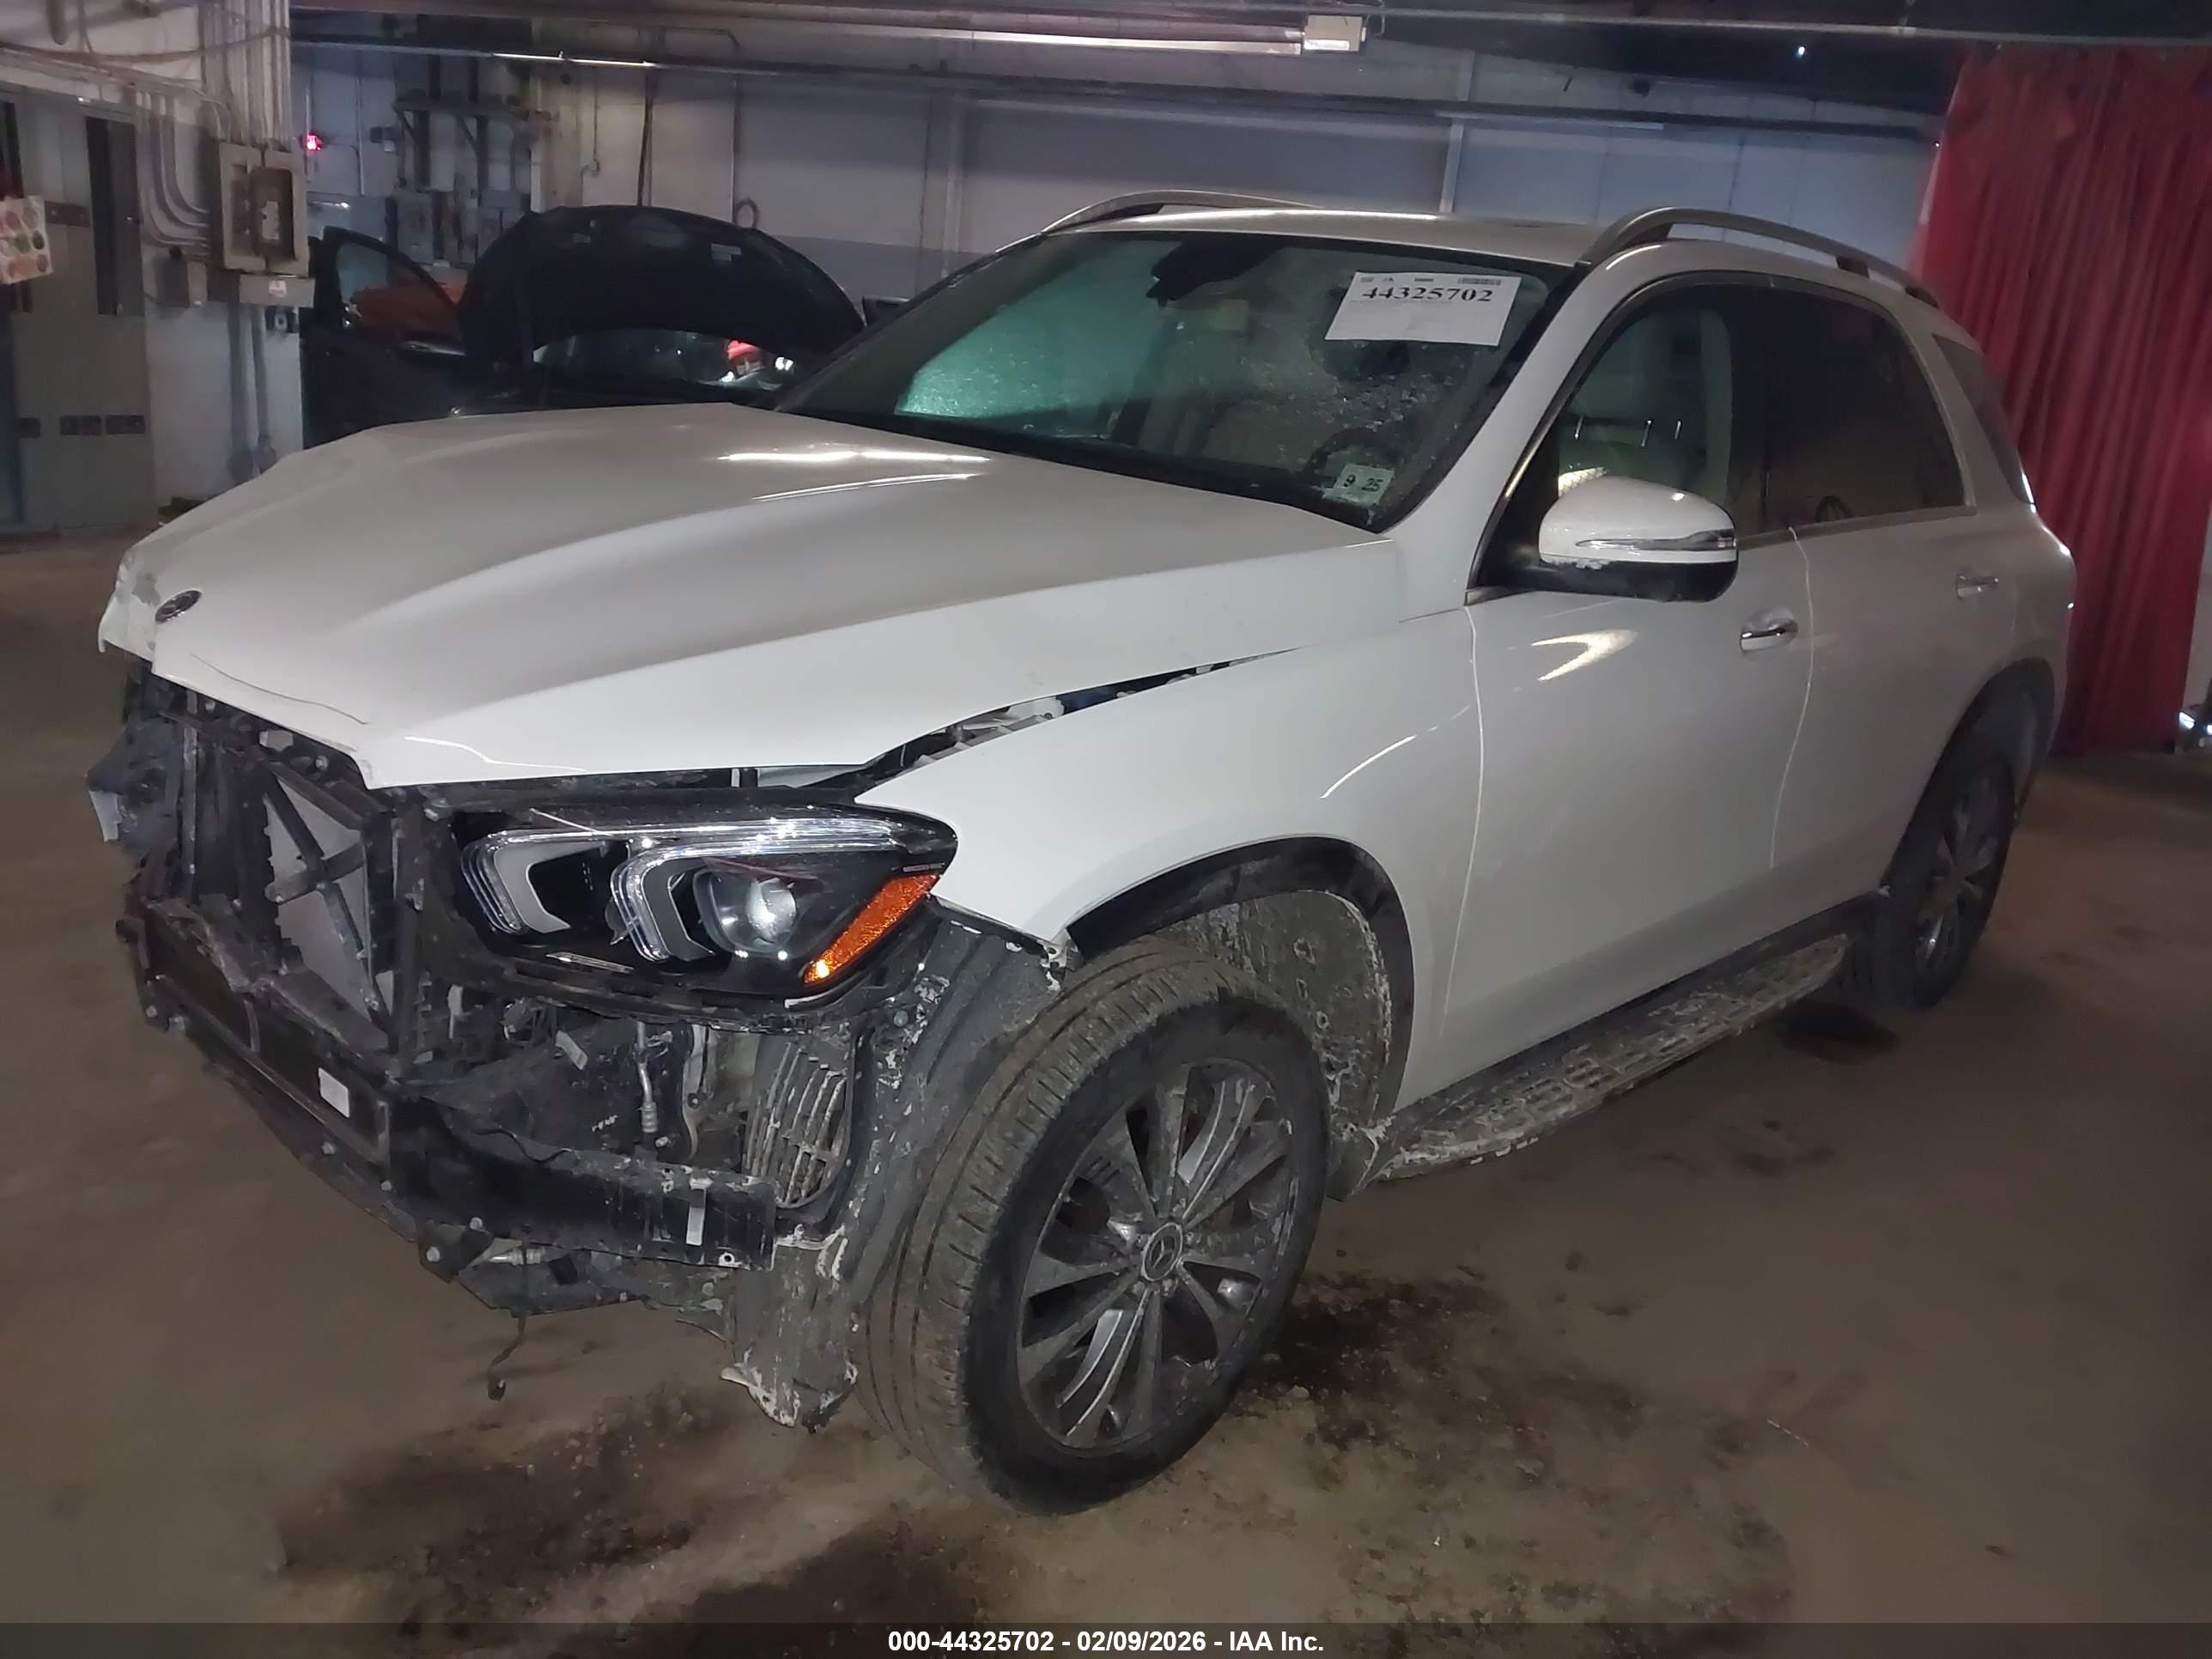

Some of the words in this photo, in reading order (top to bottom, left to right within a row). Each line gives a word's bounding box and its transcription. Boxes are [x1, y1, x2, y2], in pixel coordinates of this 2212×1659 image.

[1362, 286, 1494, 302] 44325702
[1343, 473, 1357, 488] 9
[1361, 477, 1384, 492] 25
